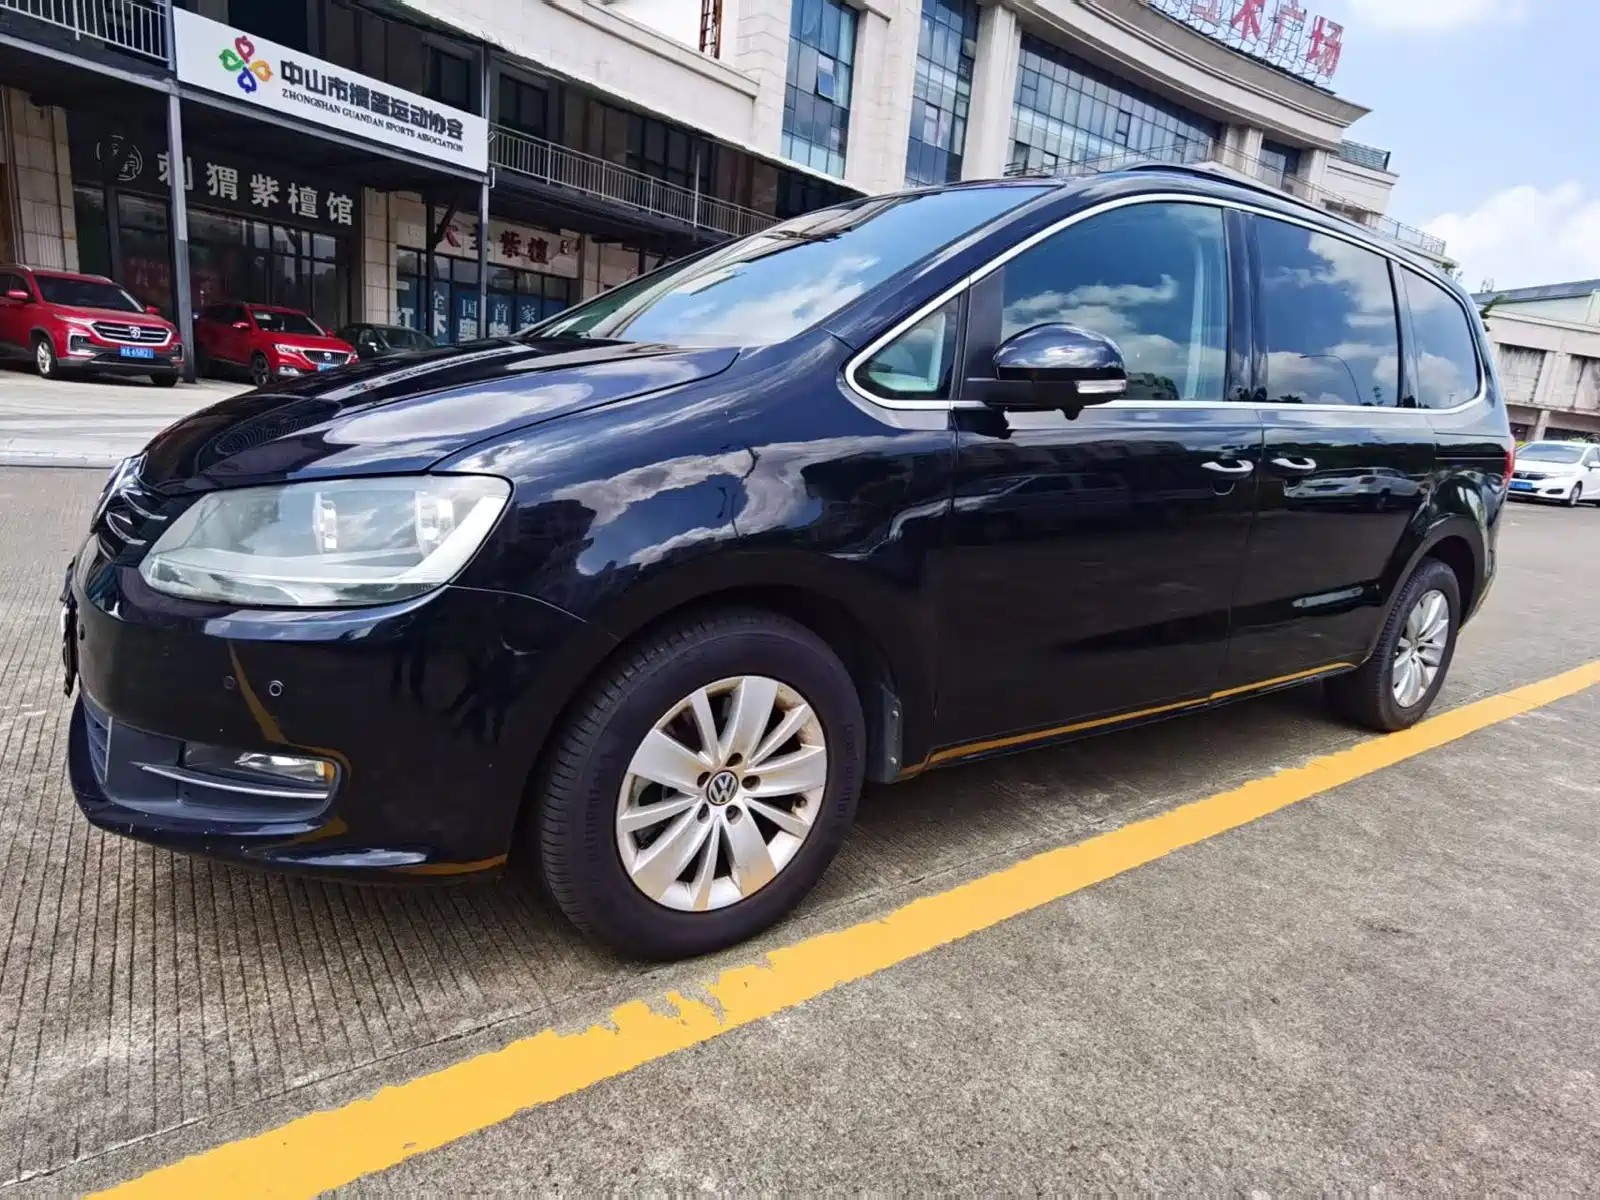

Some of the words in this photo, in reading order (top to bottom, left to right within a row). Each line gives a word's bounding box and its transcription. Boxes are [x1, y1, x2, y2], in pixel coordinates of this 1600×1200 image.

[282, 88, 341, 115] ZHONGSHAN
[342, 108, 384, 128] GUANDAN
[385, 121, 415, 138] SPORTS
